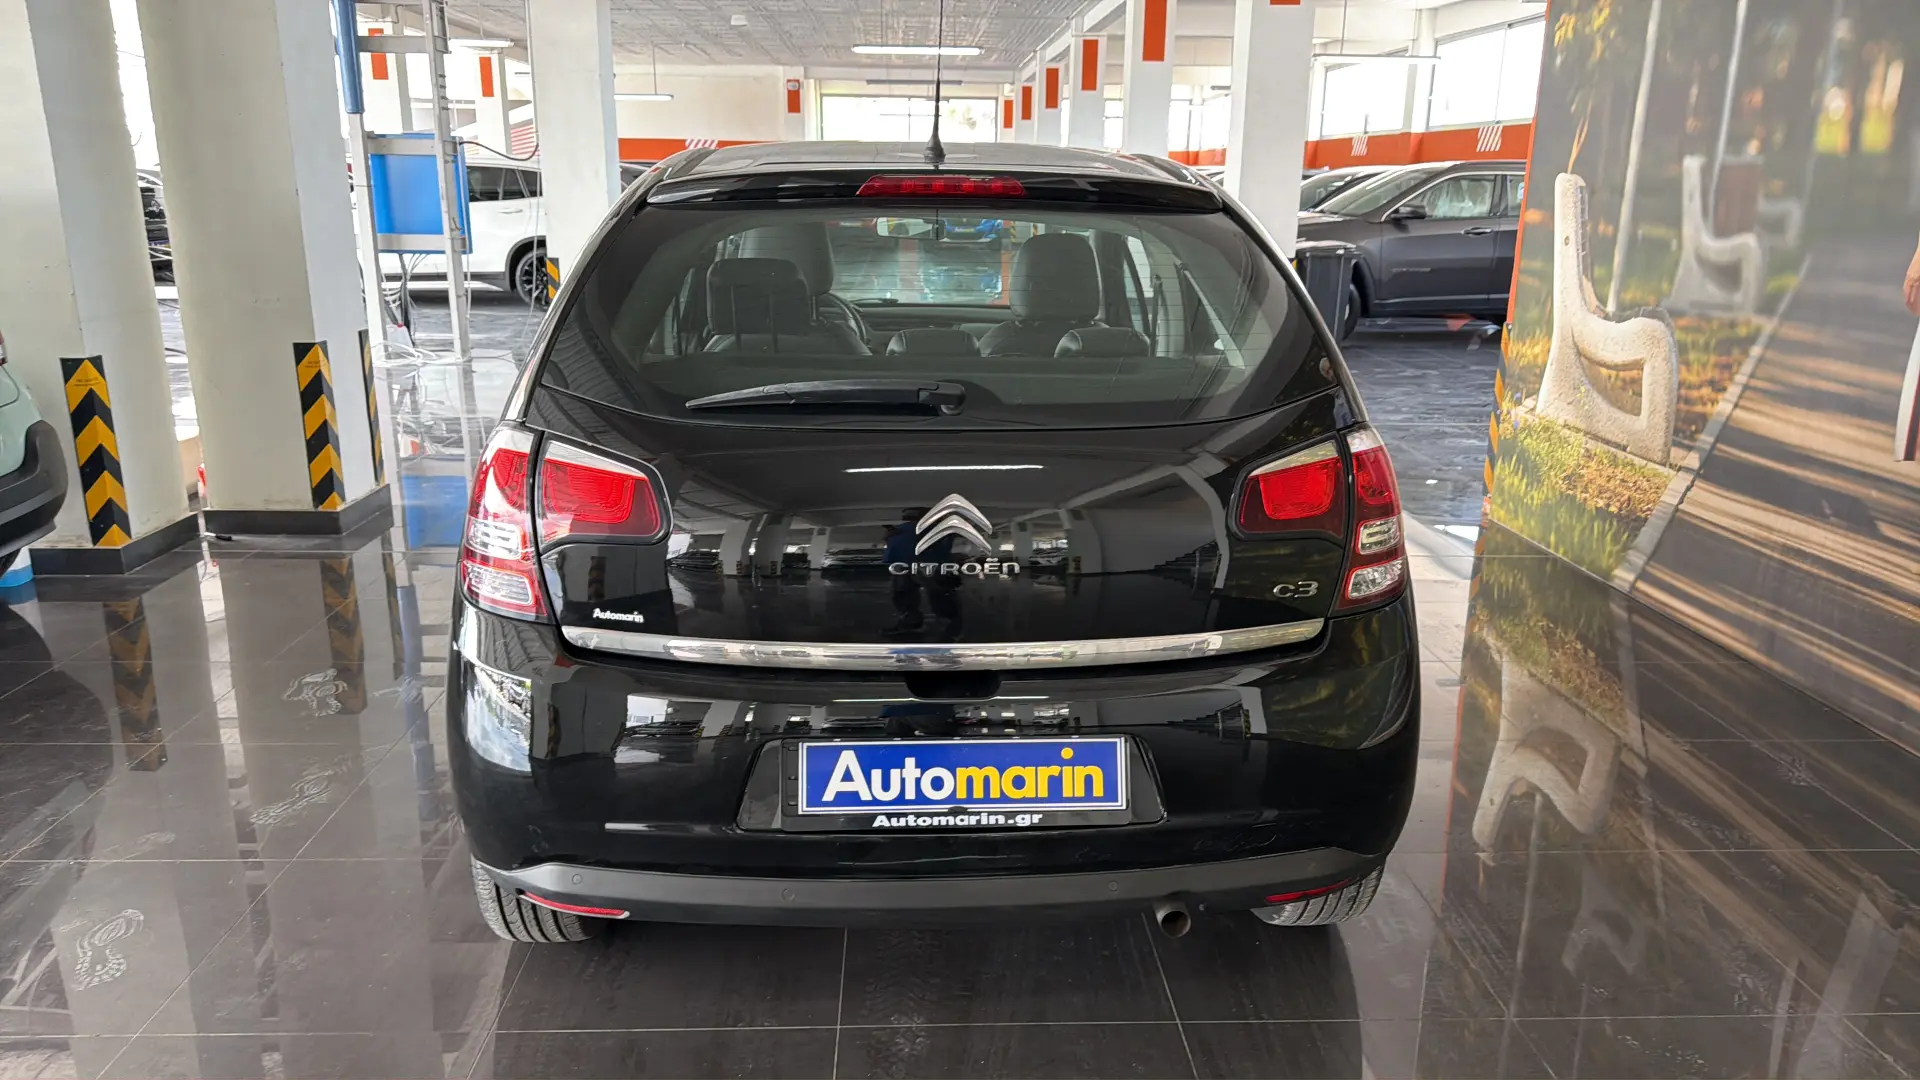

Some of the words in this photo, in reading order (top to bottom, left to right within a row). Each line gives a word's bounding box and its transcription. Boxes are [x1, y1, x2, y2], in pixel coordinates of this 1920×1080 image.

[1273, 580, 1319, 598] C3
[592, 607, 645, 624] Automarin
[821, 746, 1104, 802] Automarin
[872, 811, 1043, 828] Automarin.gr
